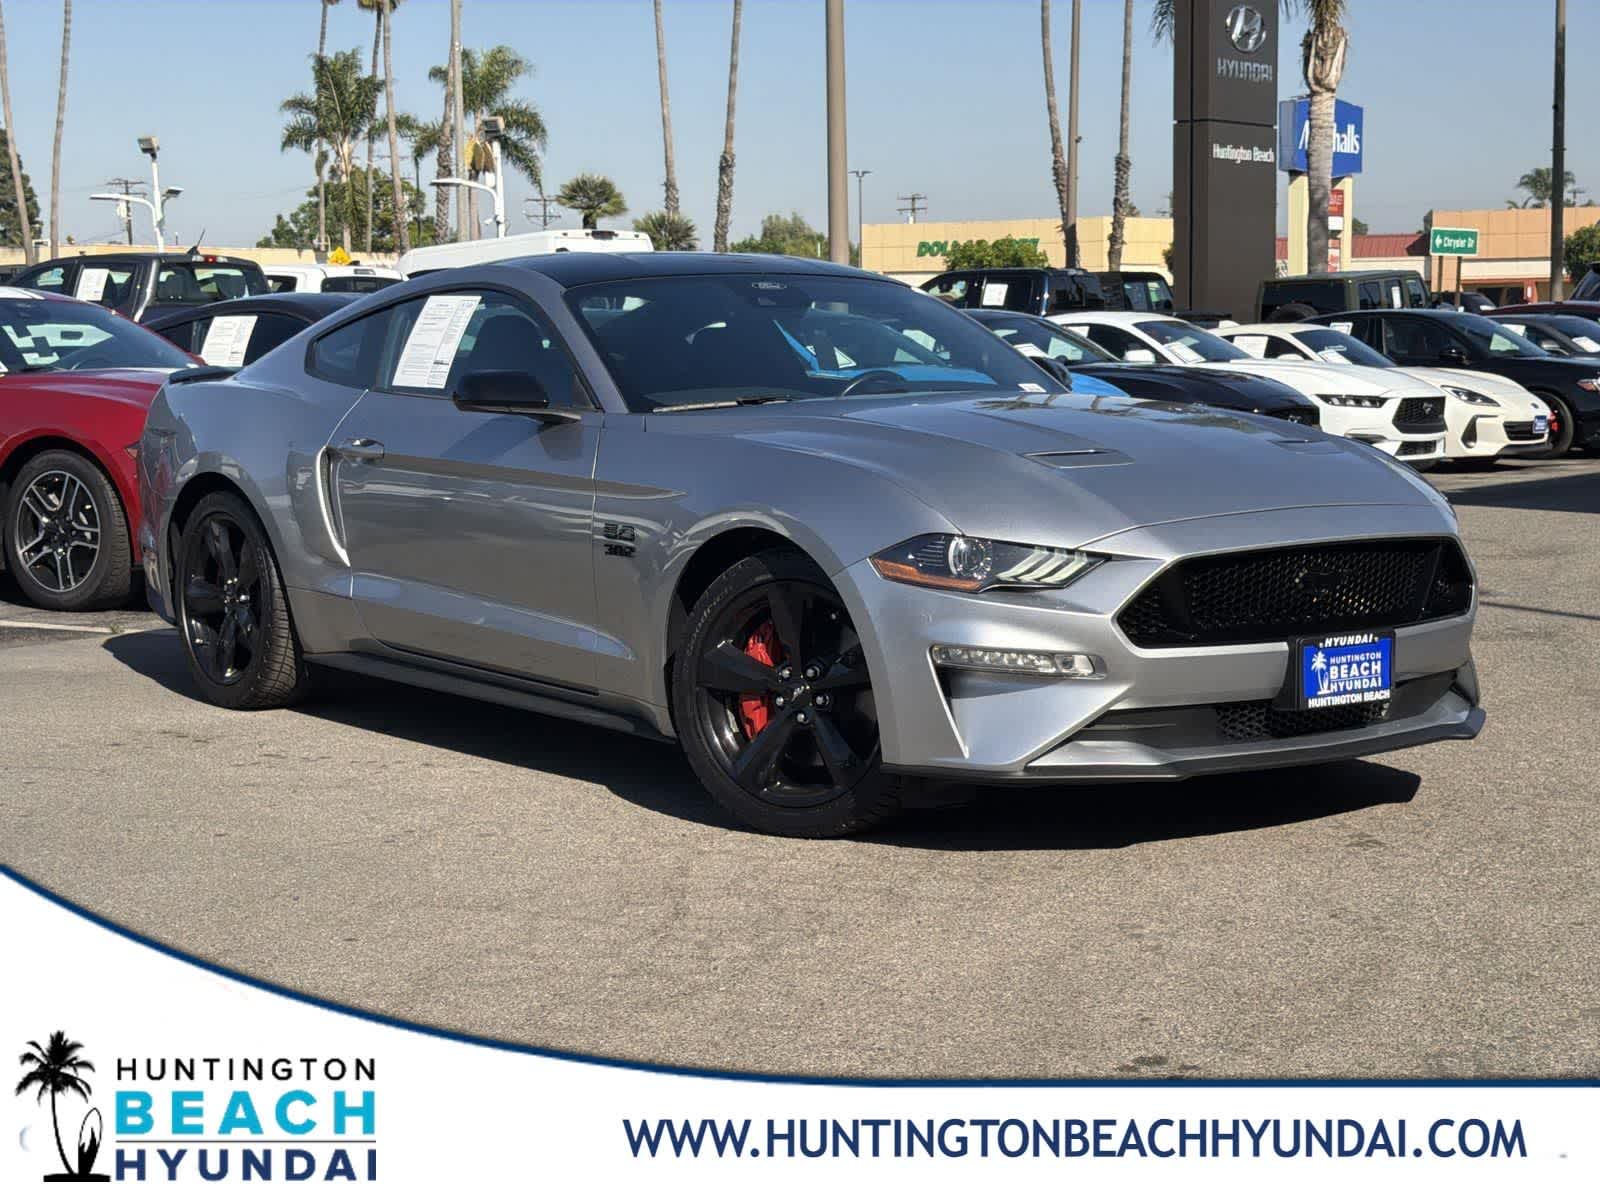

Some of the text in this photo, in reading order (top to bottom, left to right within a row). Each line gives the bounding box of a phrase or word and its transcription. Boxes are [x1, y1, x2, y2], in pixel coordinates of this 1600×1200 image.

[1217, 58, 1272, 81] HYUNDAI
[1298, 119, 1360, 154] Mhalls
[1212, 143, 1275, 163] Huntington Beach
[1325, 633, 1374, 648] HYUNDAI
[1330, 652, 1382, 664] HUNTINGTON
[1329, 660, 1381, 679] BEACH
[1330, 677, 1382, 692] HYUNDAI
[1308, 689, 1391, 709] HUNTINGTON BEACH
